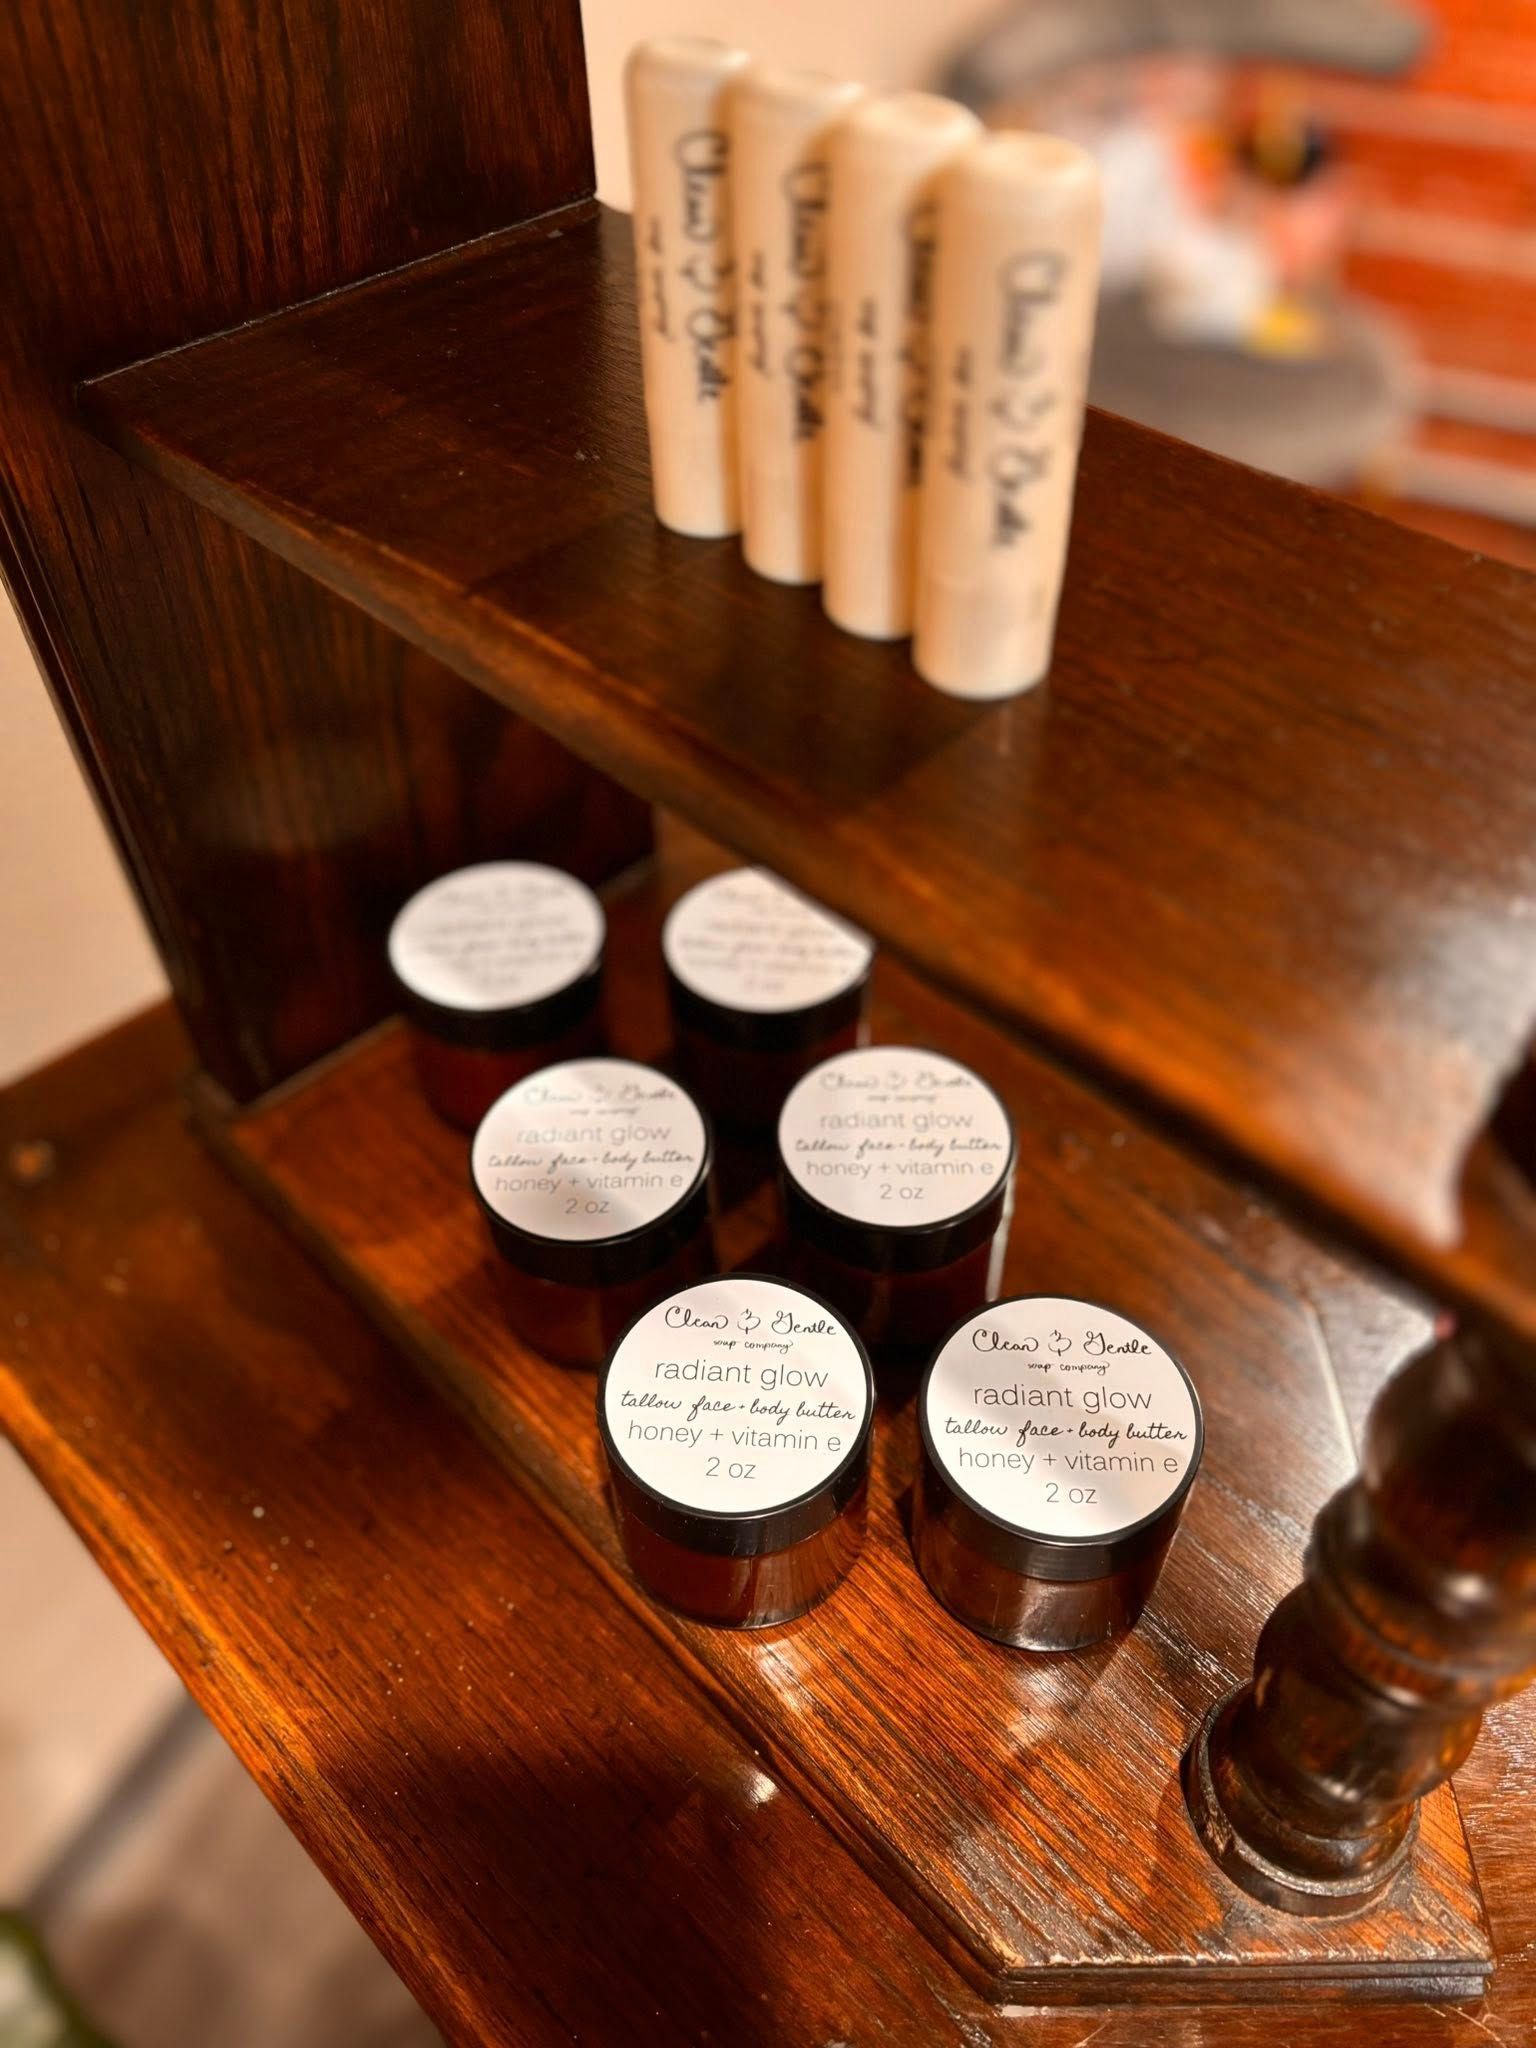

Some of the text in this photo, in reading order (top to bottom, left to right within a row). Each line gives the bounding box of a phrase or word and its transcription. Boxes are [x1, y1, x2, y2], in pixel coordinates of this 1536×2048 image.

[820, 1112, 973, 1132] radiant glow
[516, 1123, 671, 1146] radiant glow
[806, 1161, 993, 1179] honey + vitamin e
[495, 1174, 683, 1194] honey + vitamin e
[880, 1184, 924, 1199] 2 oz
[565, 1199, 610, 1214] 2 oz
[665, 1306, 728, 1329] Clean
[771, 1311, 836, 1336] Gentle
[744, 1340, 794, 1354] company
[973, 1328, 1039, 1352] Clean
[1084, 1331, 1152, 1356] Gentle
[655, 1359, 829, 1391] radiant glow
[1060, 1361, 1111, 1375] company
[621, 1391, 682, 1409] tallow
[687, 1396, 736, 1422] face
[750, 1398, 791, 1426] body
[796, 1402, 856, 1420] butter
[974, 1384, 1152, 1414] radiant glow
[628, 1420, 841, 1451] honey + vitamin e
[944, 1417, 1008, 1434] tallow
[1016, 1420, 1064, 1447] face
[1079, 1422, 1119, 1448] body
[1127, 1423, 1187, 1440] butter
[706, 1457, 756, 1479] 2 oz
[959, 1448, 1178, 1474] honey + vitamin e
[1046, 1483, 1097, 1504] 2 oz
